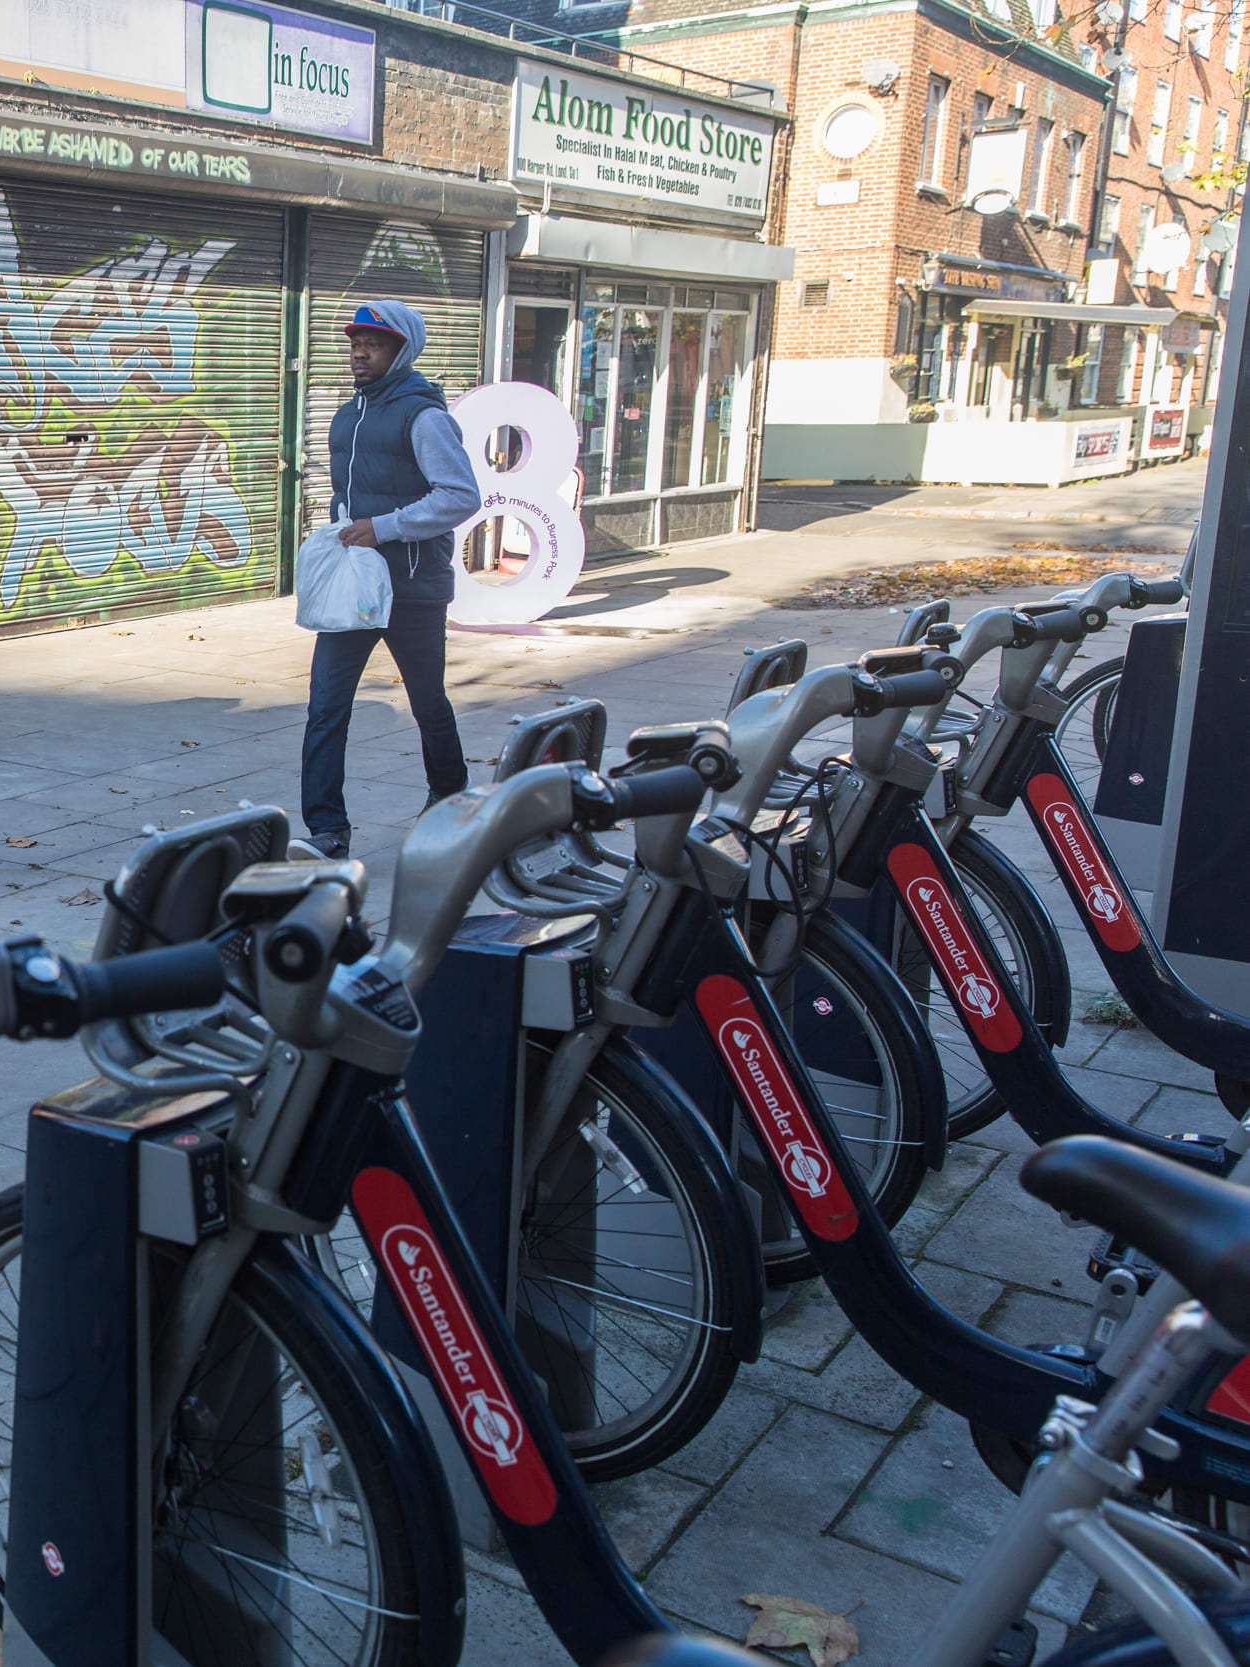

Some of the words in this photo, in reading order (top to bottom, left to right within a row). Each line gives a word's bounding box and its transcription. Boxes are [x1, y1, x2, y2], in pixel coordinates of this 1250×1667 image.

[274, 41, 293, 87] in
[299, 45, 350, 98] focus
[532, 75, 613, 137] Alom
[622, 96, 691, 152] Food
[699, 113, 762, 166] Store
[21, 127, 46, 153] BE
[48, 131, 134, 168] ASHAMED
[140, 147, 165, 170] OF
[168, 150, 199, 177] OUR
[202, 154, 251, 184] TEARS
[556, 134, 601, 157] Specialist
[604, 143, 612, 159] In
[615, 146, 636, 163] Halal
[639, 151, 665, 170] Meat,
[668, 155, 700, 175] Chicken
[702, 162, 707, 176] &
[710, 163, 737, 184] Poultry
[597, 165, 615, 182] Fish
[618, 168, 624, 183] &
[627, 170, 653, 189] Fresh
[656, 175, 700, 196] Vegetables
[509, 498, 542, 517] minutes
[542, 513, 550, 524] to
[547, 523, 558, 559] Burgess
[542, 561, 557, 581] Park
[1059, 822, 1097, 882] Santander
[925, 901, 970, 971] Santander
[742, 1049, 794, 1138] Santander
[409, 1264, 476, 1386] Santander
